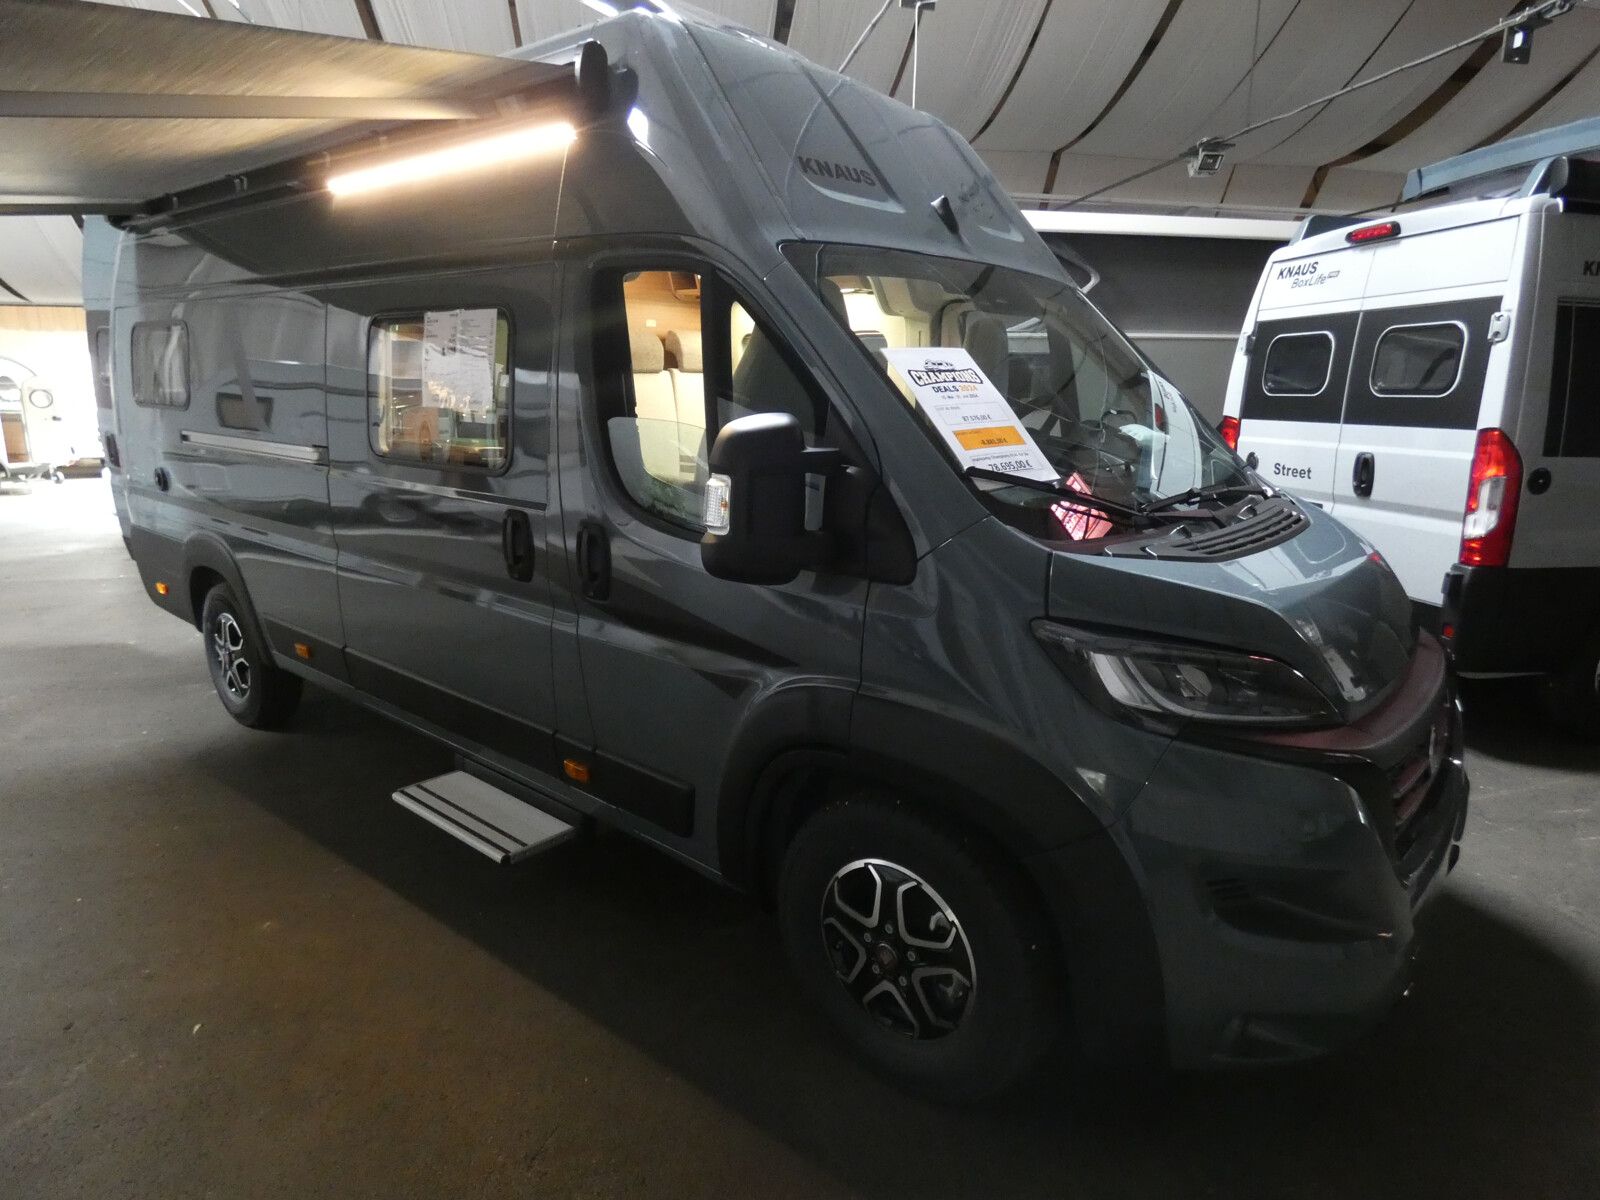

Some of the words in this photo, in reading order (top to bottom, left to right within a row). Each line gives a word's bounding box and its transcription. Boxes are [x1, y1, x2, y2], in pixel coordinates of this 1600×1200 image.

[798, 156, 876, 187] KNAUS
[1277, 261, 1319, 280] KNAUS
[1291, 273, 1327, 289] BoxLife
[910, 369, 981, 385] CHAMPIONS
[932, 385, 959, 393] DEALS
[1273, 462, 1312, 479] Street
